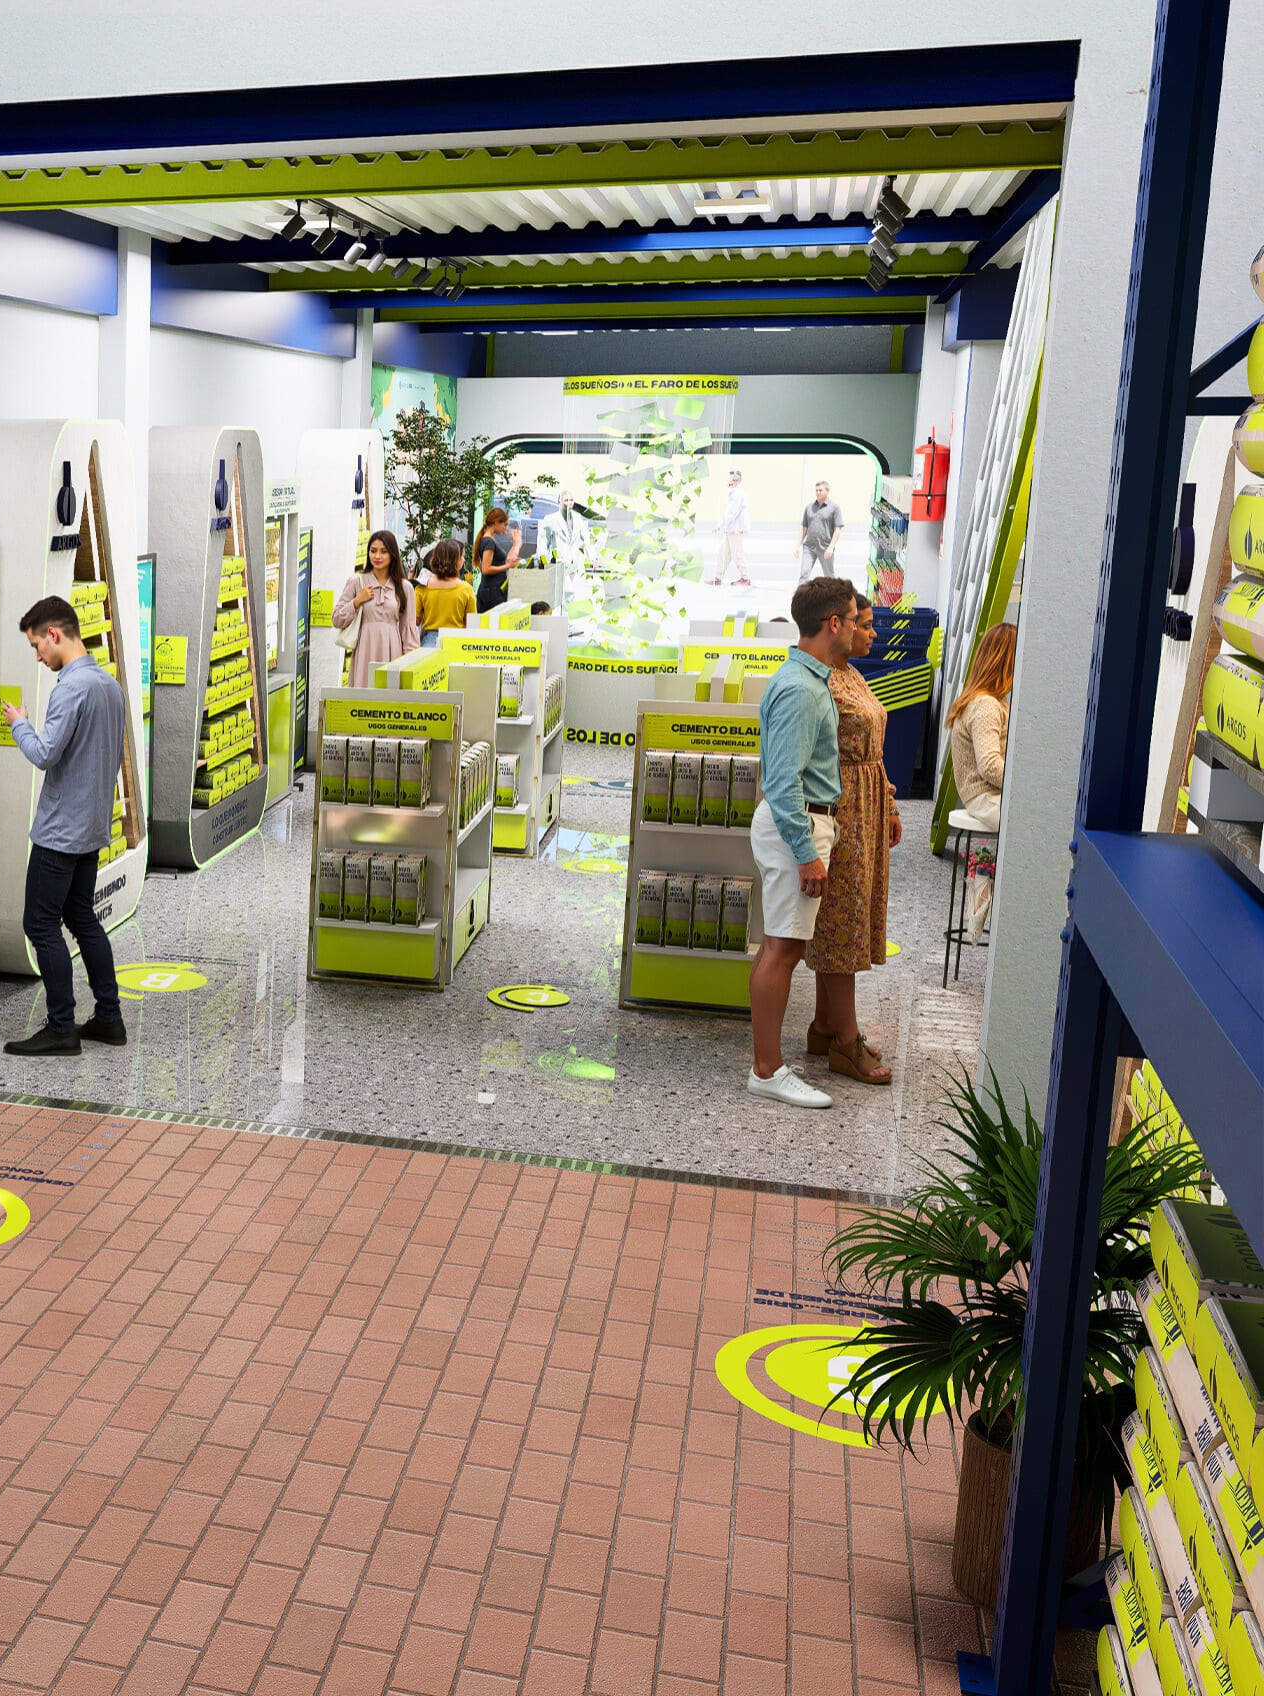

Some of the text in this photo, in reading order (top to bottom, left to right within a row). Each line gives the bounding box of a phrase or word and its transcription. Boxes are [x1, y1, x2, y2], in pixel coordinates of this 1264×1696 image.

[580, 379, 618, 390] SUEÑOS
[635, 380, 648, 389] EL
[651, 380, 684, 389] FARO
[686, 380, 700, 389] DE
[702, 380, 719, 389] LOS
[461, 644, 537, 654] CEMENTO BLANCO
[568, 661, 593, 671] FARO
[594, 663, 609, 673] DE
[611, 664, 634, 674] LOS
[350, 708, 447, 722] CEMENTO BLANCO
[387, 724, 427, 732] GENERALES
[671, 723, 728, 735] CEMENTO
[690, 738, 756, 748] USOS GENERALES
[140, 972, 181, 989] B
[755, 1288, 785, 1298] DE
